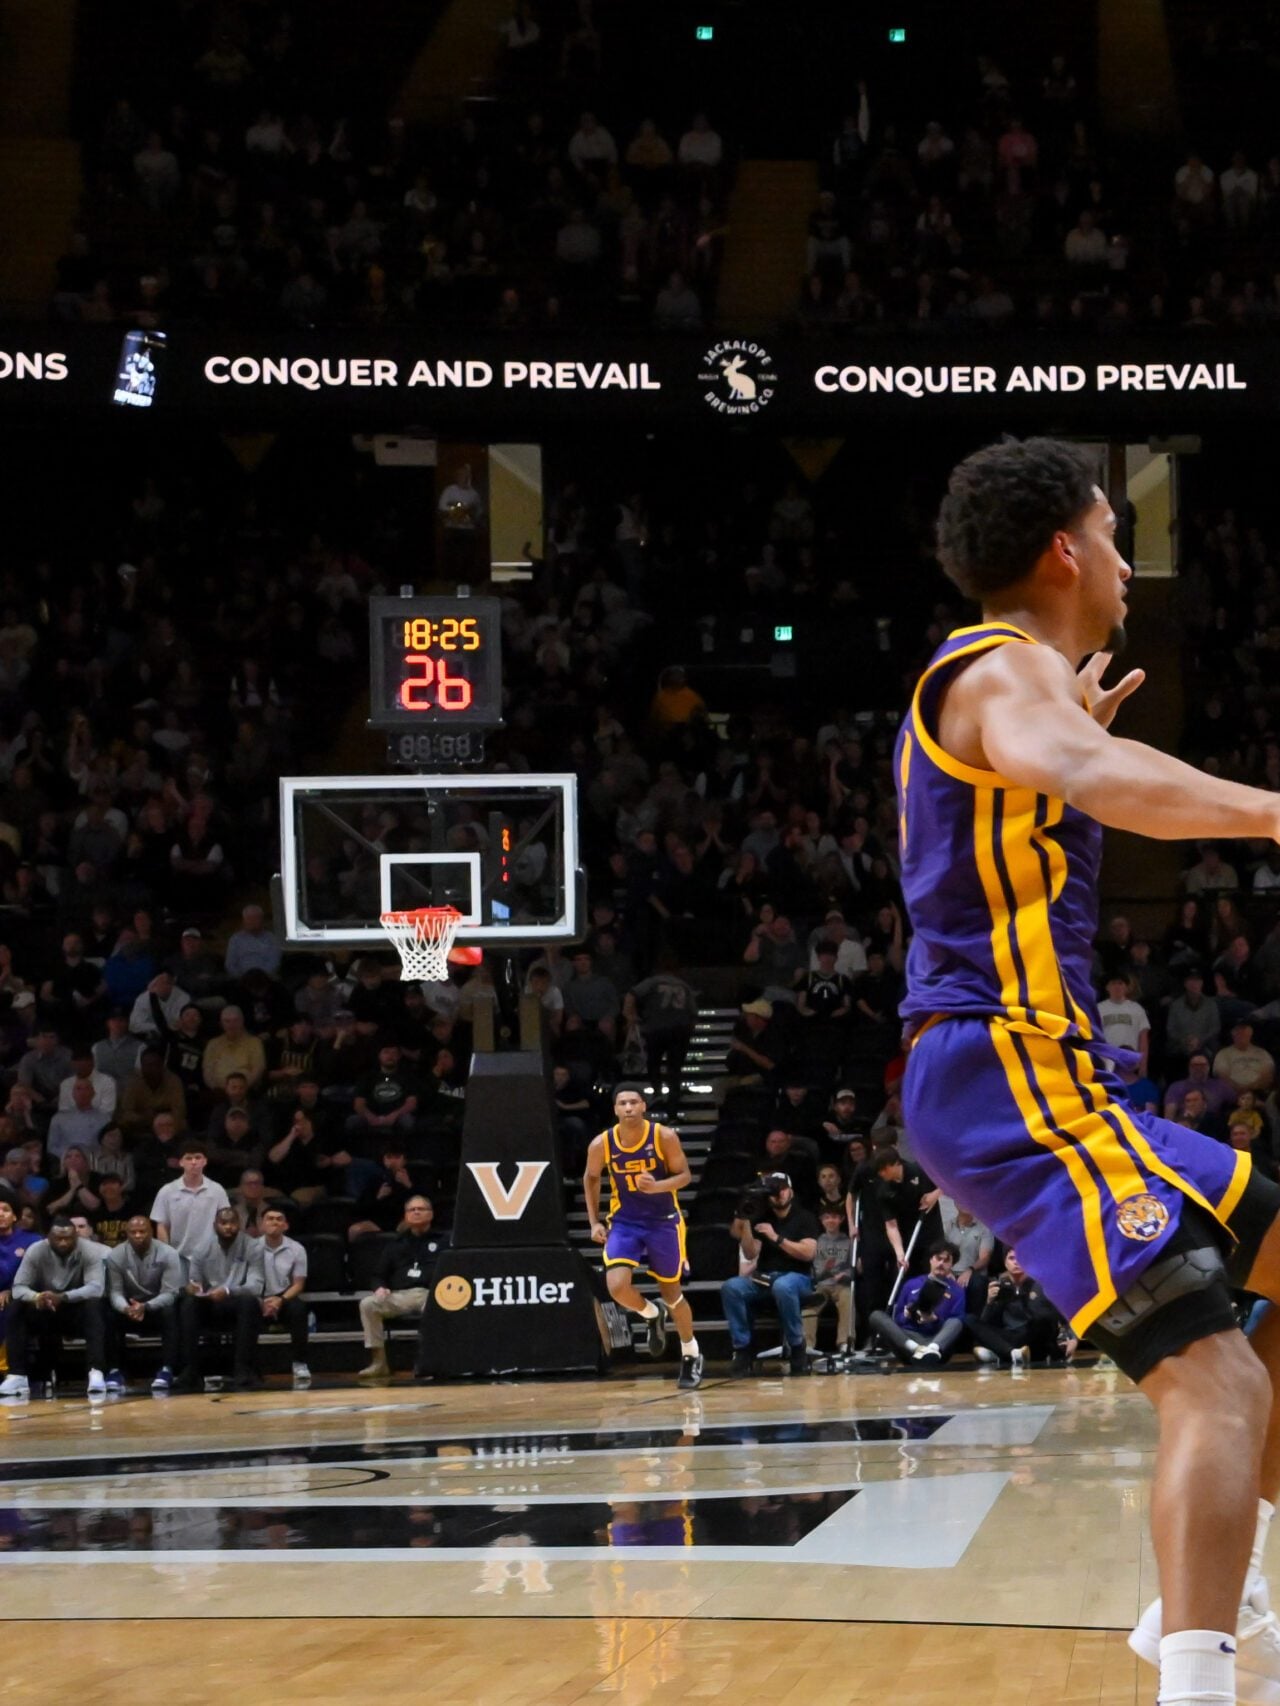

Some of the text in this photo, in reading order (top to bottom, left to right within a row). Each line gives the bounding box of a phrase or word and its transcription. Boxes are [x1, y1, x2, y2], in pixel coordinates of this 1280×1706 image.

[703, 340, 772, 365] JACKALOPE
[204, 356, 661, 391] CONQUER AND PREVAIL
[814, 363, 1247, 398] CONQUER AND PREVAIL
[704, 391, 760, 414] BREWING
[404, 618, 480, 651] 18:25
[401, 655, 471, 711] 26
[612, 1158, 657, 1174] LSU
[465, 1161, 550, 1221] V
[473, 1276, 574, 1306] Hiller
